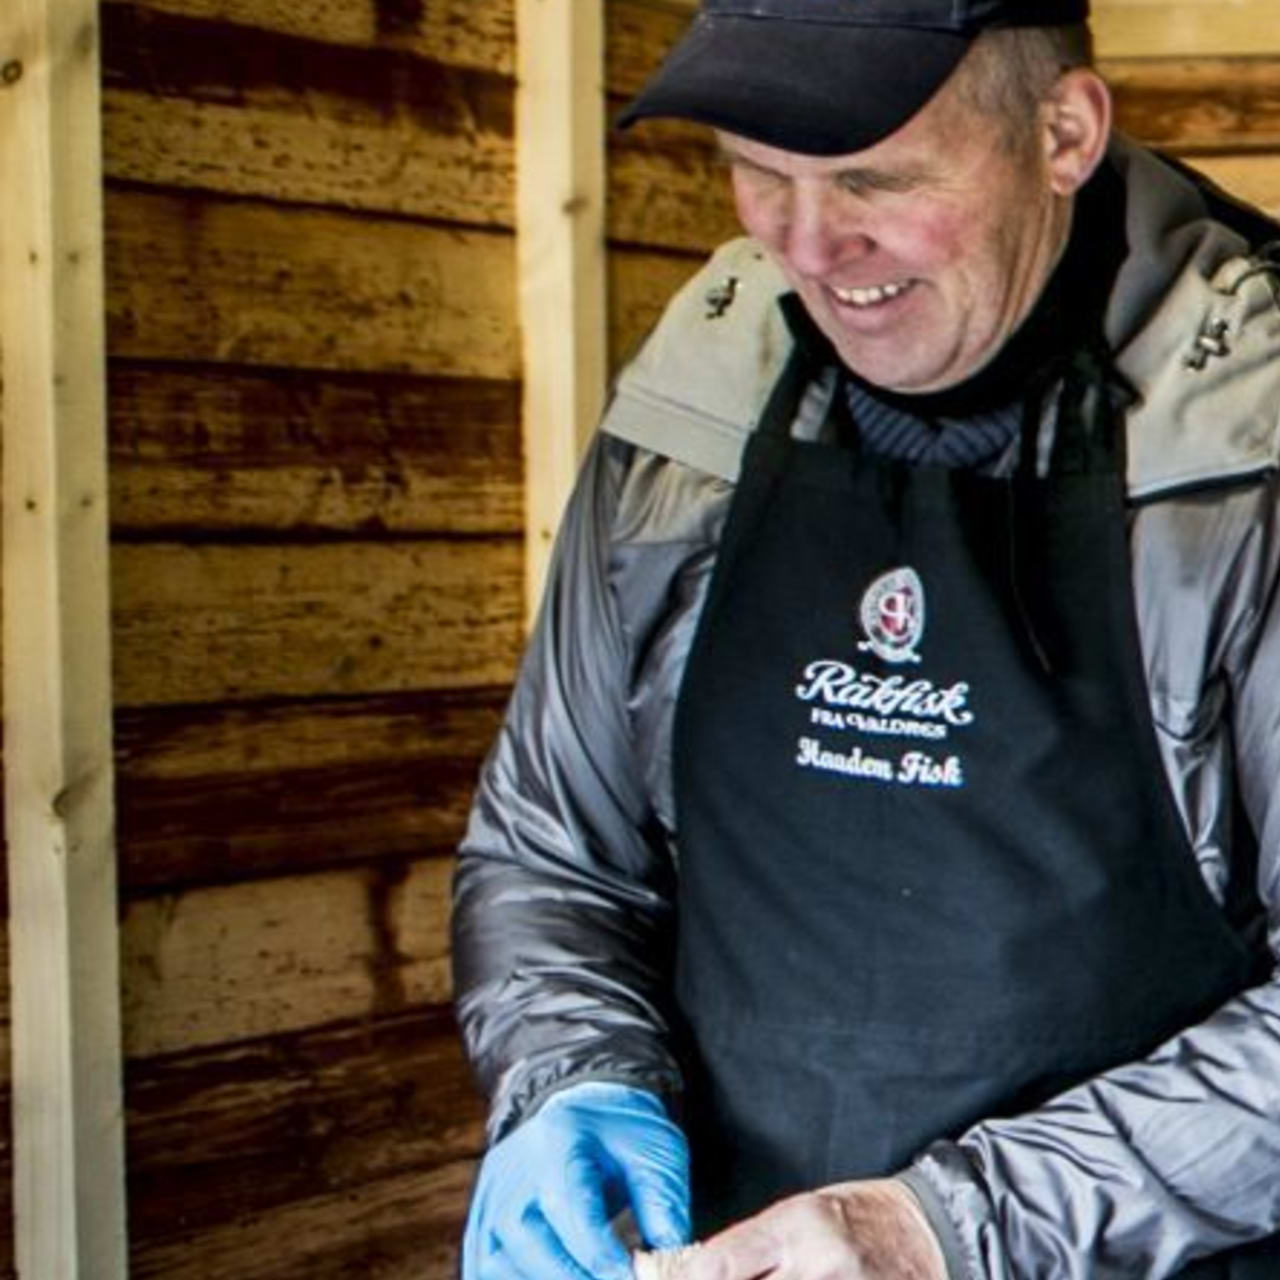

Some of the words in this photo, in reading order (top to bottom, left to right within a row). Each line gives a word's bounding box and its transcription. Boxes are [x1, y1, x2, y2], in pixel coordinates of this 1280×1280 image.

[811, 707, 845, 729] FRA
[846, 711, 948, 740] VALDRES
[896, 750, 963, 787] Fisk
